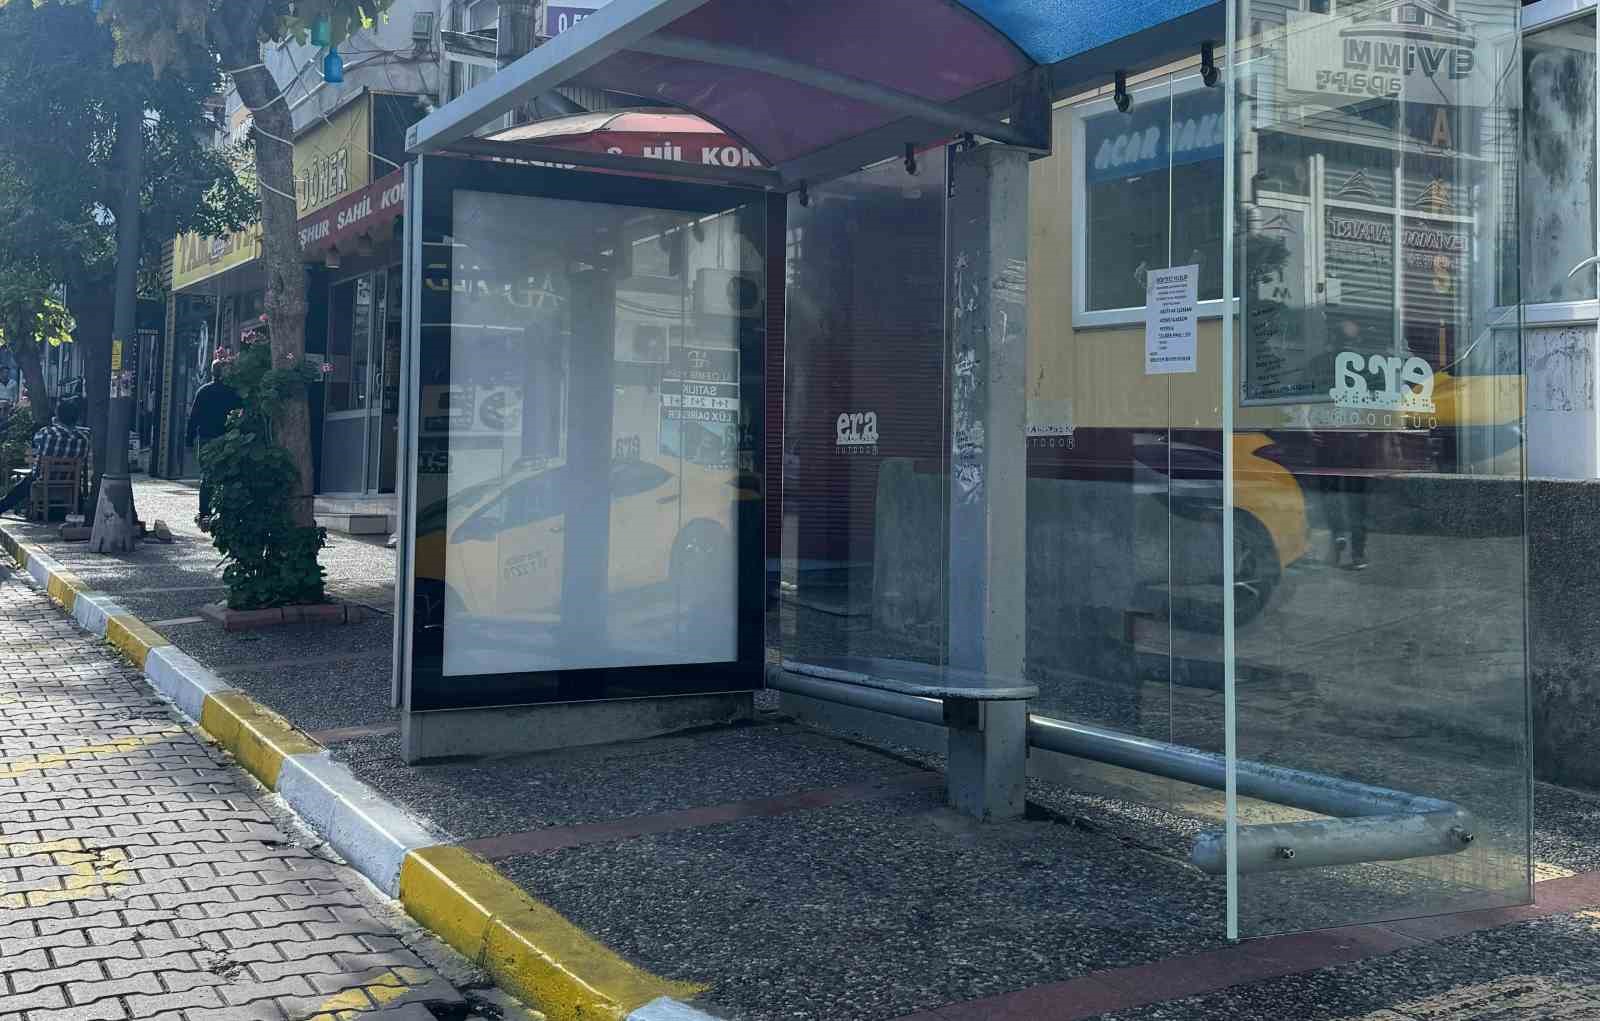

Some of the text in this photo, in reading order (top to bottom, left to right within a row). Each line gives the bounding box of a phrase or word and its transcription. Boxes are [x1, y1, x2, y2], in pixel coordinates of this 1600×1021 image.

[298, 219, 330, 250] ŞHUR
[337, 195, 373, 230] SAHİL
[836, 411, 880, 445] era
